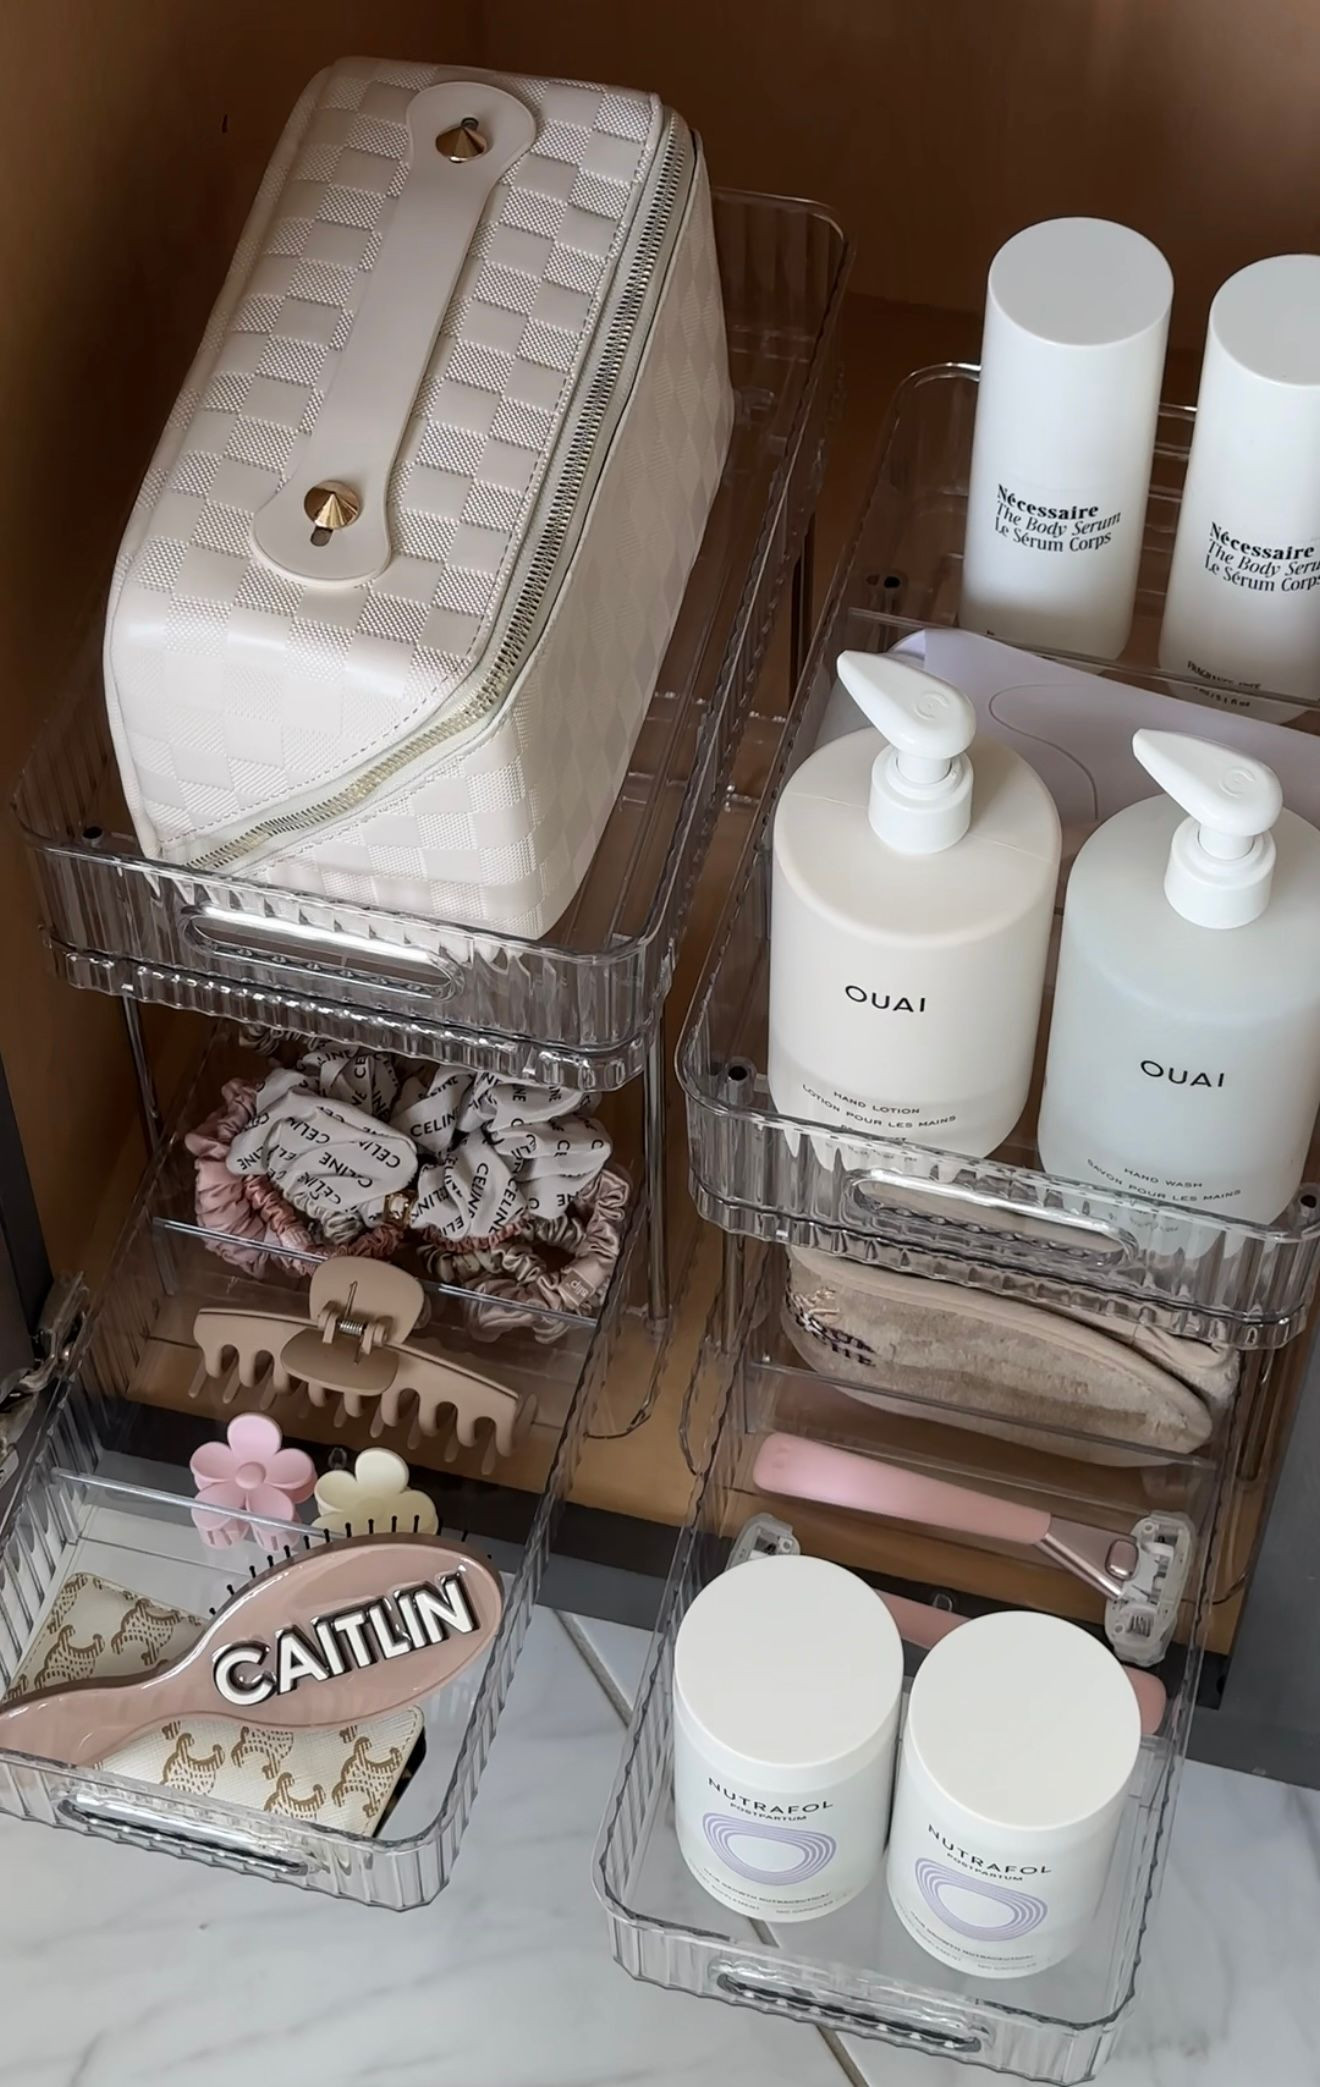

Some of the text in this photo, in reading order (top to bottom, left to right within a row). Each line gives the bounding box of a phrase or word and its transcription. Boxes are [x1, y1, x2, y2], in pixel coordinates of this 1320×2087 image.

[996, 500, 1121, 538] The Body Serum
[997, 483, 1099, 520] Nécessaire
[995, 516, 1112, 552] Le Sérum Corps
[1209, 521, 1315, 560] Nécessaire
[1205, 554, 1220, 576] Le
[1223, 566, 1275, 592] Sérum
[1208, 538, 1320, 578] The Body Seru
[844, 984, 926, 1013] OUAI
[1140, 1059, 1225, 1088] OUAI
[802, 1083, 956, 1129] LOTION POUR LES MAINS
[834, 1090, 920, 1115] HAND LOTION
[285, 1116, 330, 1144] CELIN
[410, 1107, 458, 1137] CELIN
[319, 1152, 372, 1188] CLINE
[1087, 1158, 1123, 1185] SAVON
[1128, 1184, 1166, 1199] POUR
[1203, 1189, 1241, 1201] MAINS
[1124, 1167, 1203, 1188] HAND WASH
[213, 1574, 478, 1706] CAITLIN
[708, 1777, 833, 1814] NUTRAFOL
[928, 1823, 1052, 1875] NUTRAFOL
